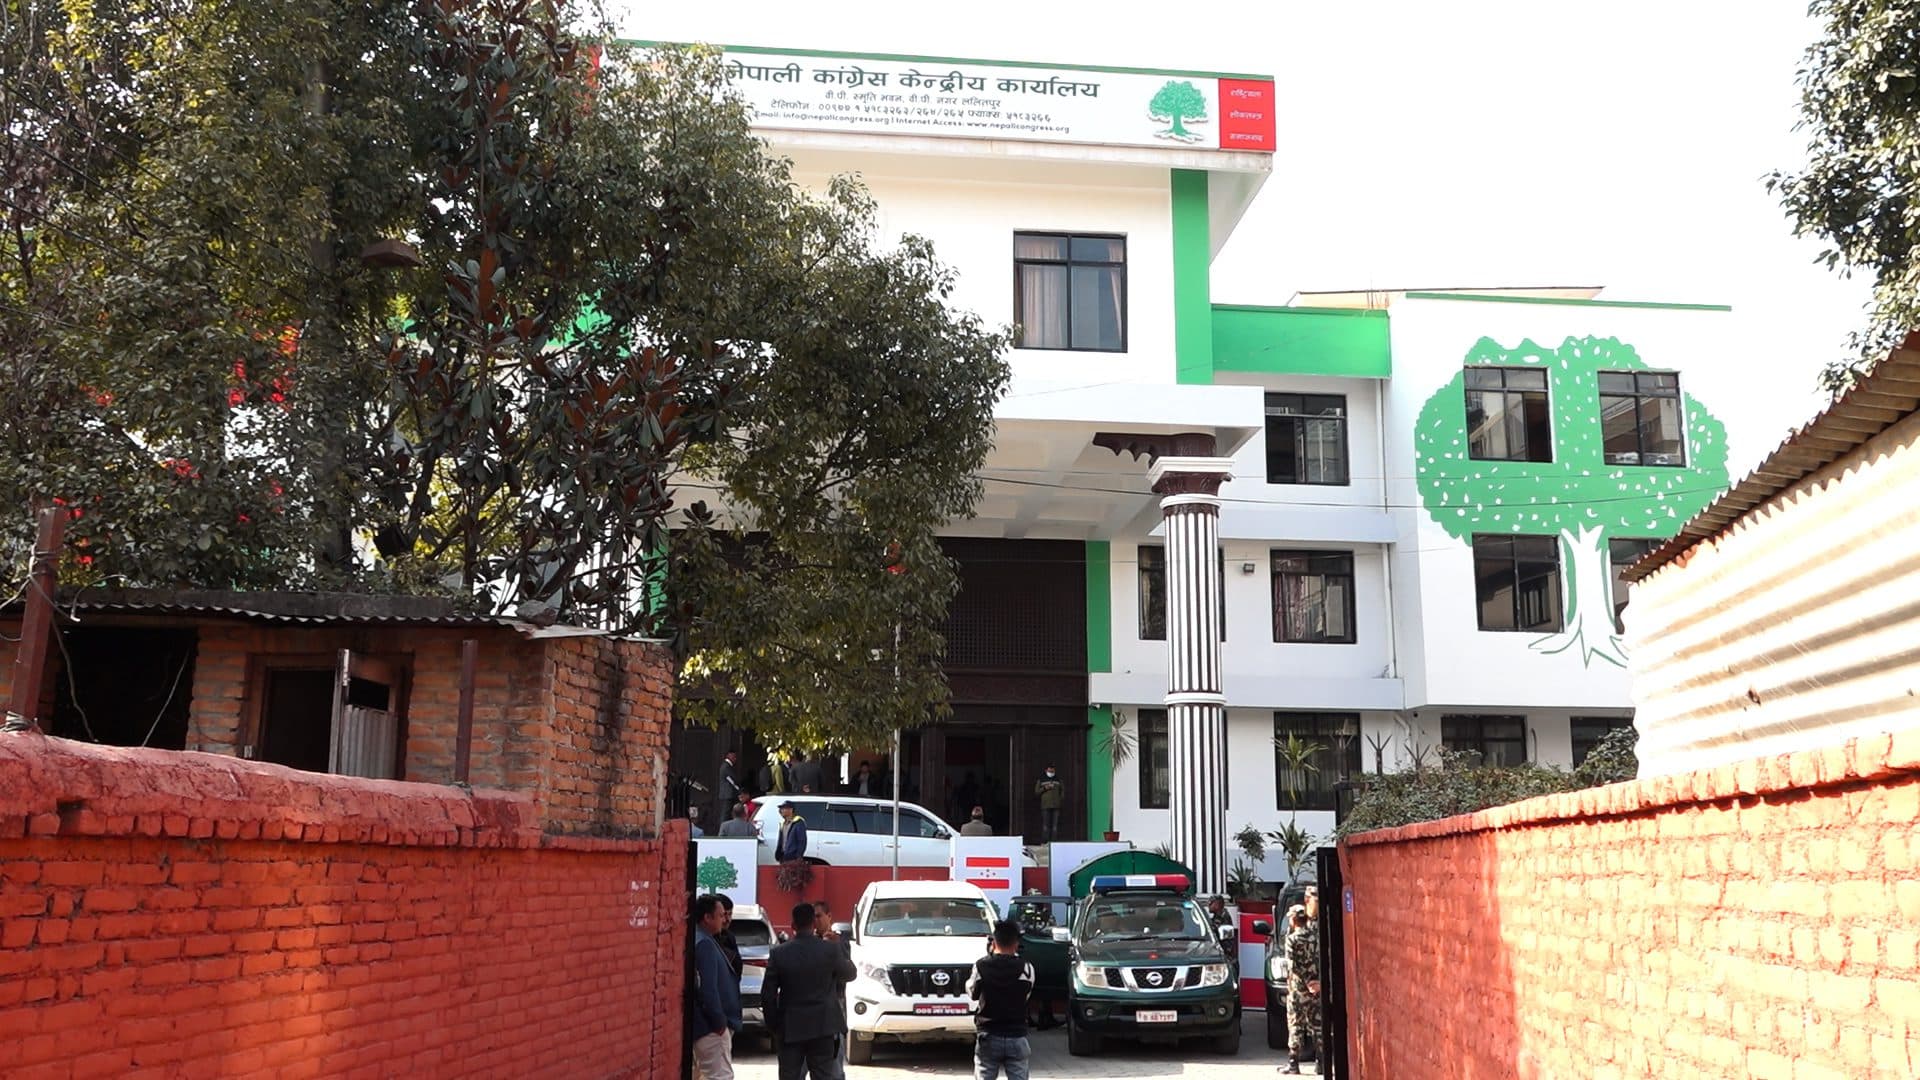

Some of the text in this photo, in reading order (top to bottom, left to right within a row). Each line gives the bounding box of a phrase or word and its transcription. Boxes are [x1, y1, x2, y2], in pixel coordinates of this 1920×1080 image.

[813, 66, 889, 88] कांग्रेस
[899, 69, 986, 93] केन्द्रीय
[997, 76, 1101, 98] कार्यालय
[896, 117, 930, 125] Internet
[966, 121, 1070, 134] www.nepalicongress.org
